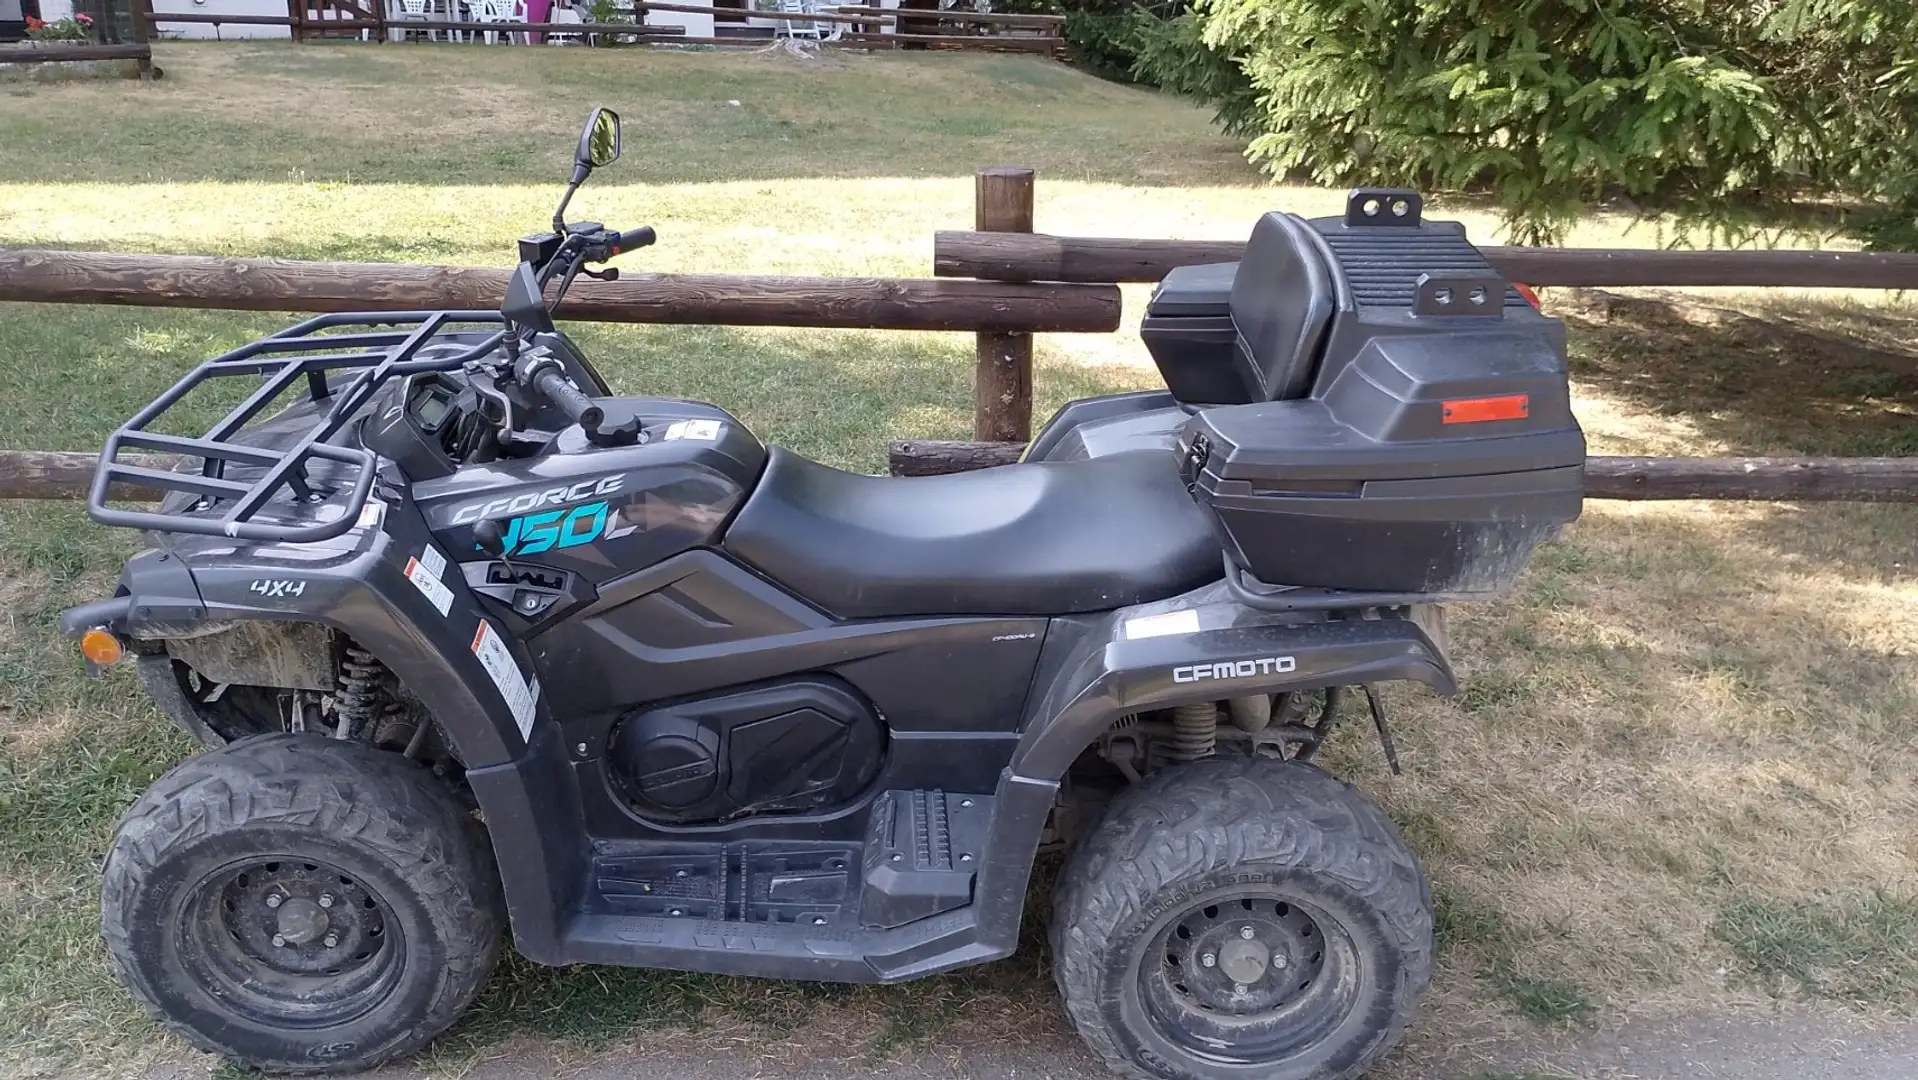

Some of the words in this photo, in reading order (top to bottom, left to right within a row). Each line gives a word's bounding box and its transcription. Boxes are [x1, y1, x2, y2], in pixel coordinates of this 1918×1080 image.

[451, 473, 627, 525] CFORCE
[250, 579, 306, 597] 4X4
[1173, 655, 1296, 683] CFMOTO
